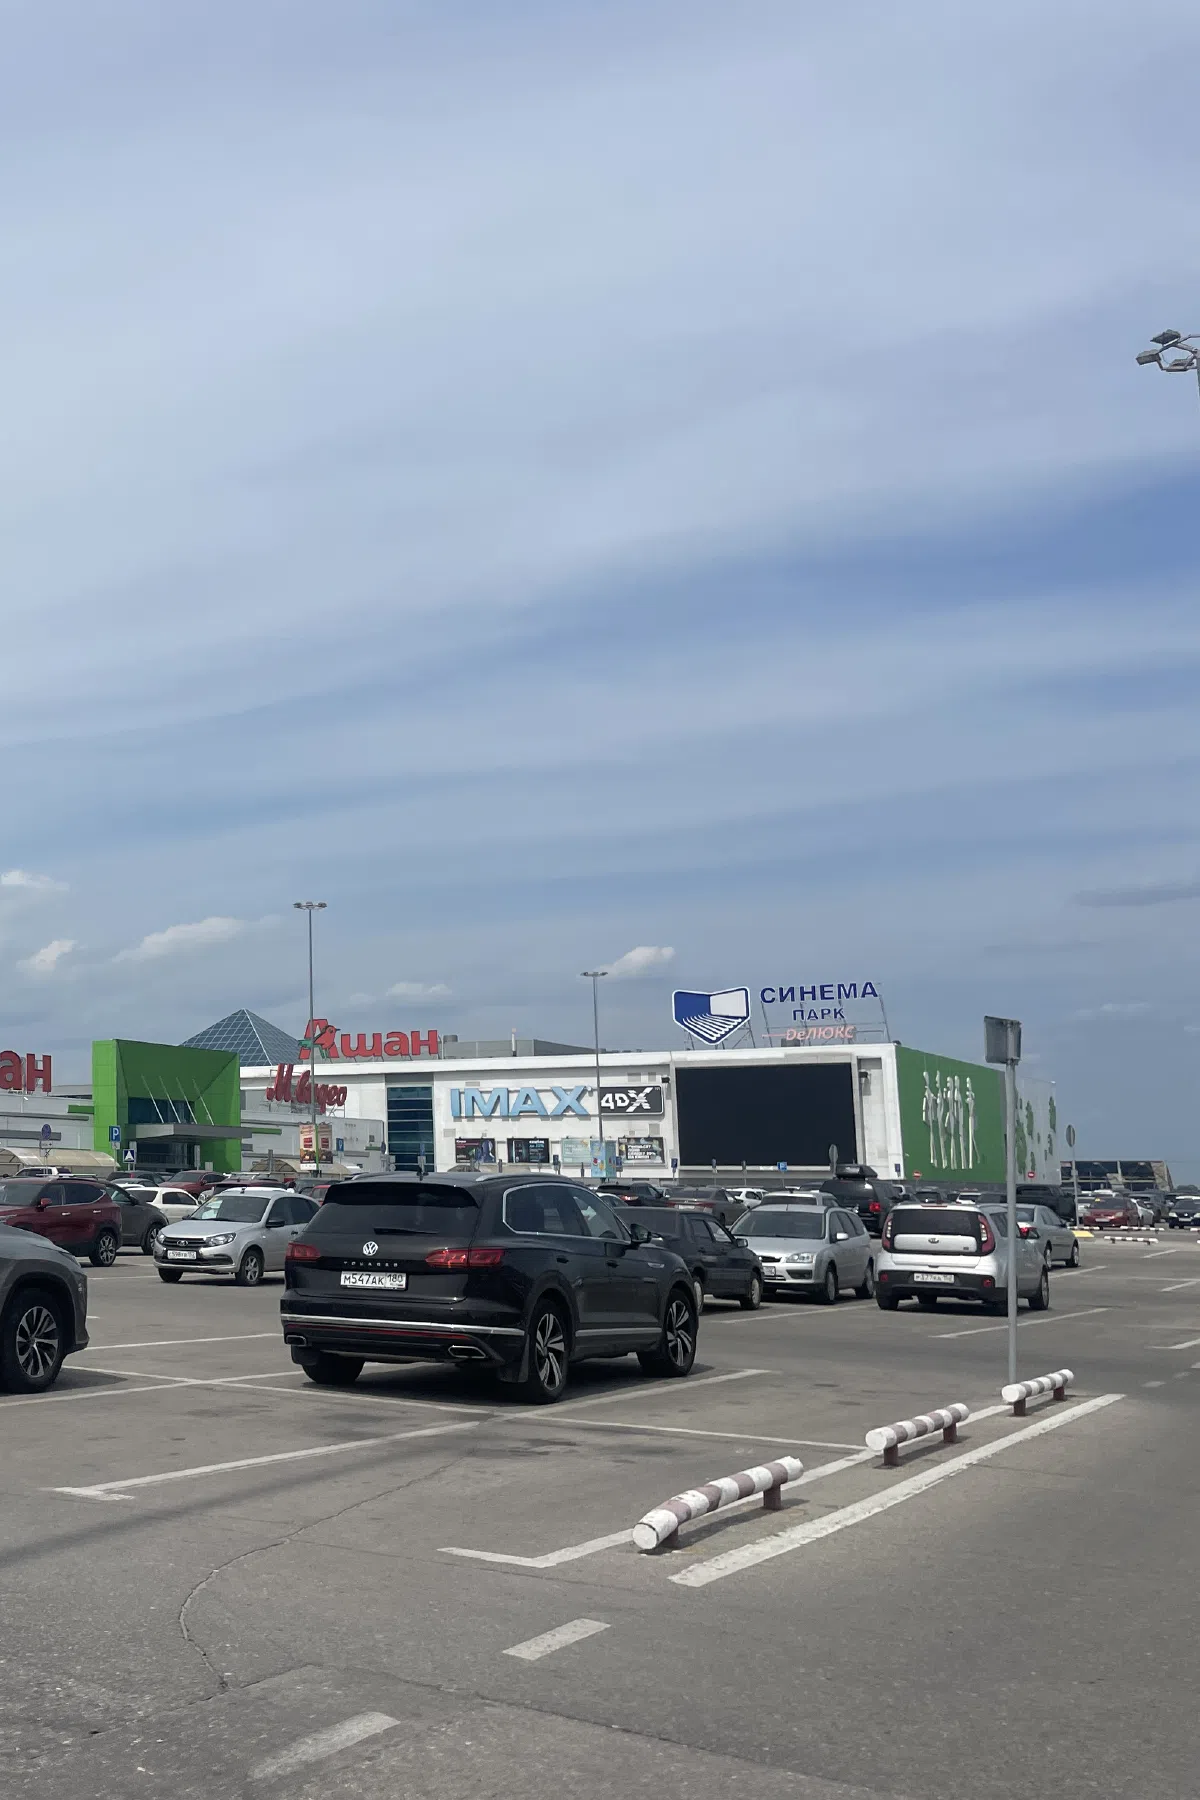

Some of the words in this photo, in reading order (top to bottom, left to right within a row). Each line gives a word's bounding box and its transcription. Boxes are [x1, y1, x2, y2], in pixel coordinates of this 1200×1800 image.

[760, 982, 878, 1003] СИНЕМА
[793, 1008, 845, 1020] ПАРК
[299, 1018, 439, 1060] Ашан
[450, 1085, 590, 1117] IMAX
[600, 1087, 653, 1112] 4DX
[112, 1127, 119, 1140] P
